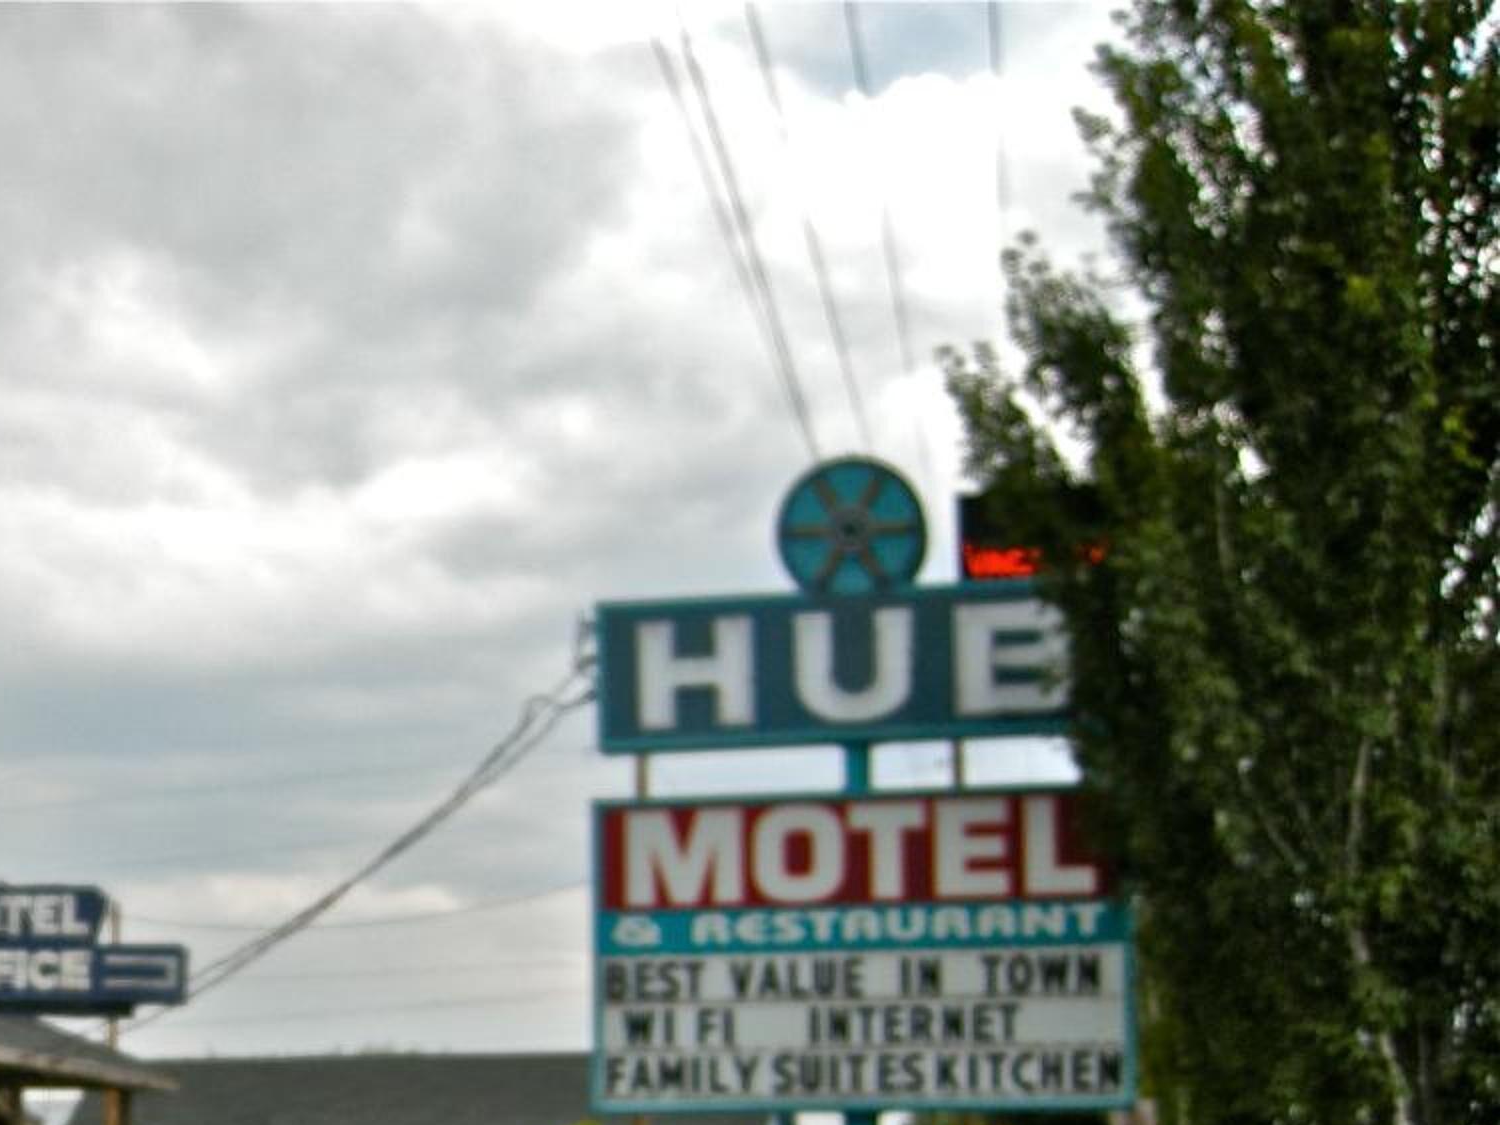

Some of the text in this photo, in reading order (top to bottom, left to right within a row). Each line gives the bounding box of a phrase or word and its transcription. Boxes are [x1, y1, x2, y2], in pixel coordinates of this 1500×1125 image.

[636, 602, 1074, 732] HUB
[624, 796, 1099, 908] MOTEL
[612, 902, 1106, 946] & RESTAURANT
[606, 953, 1101, 1001] BEST VALUE IN TOWN
[622, 1003, 1019, 1046] WI FI INTERNET
[606, 1051, 1123, 1094] FAMILY SUITES KITCHEN
